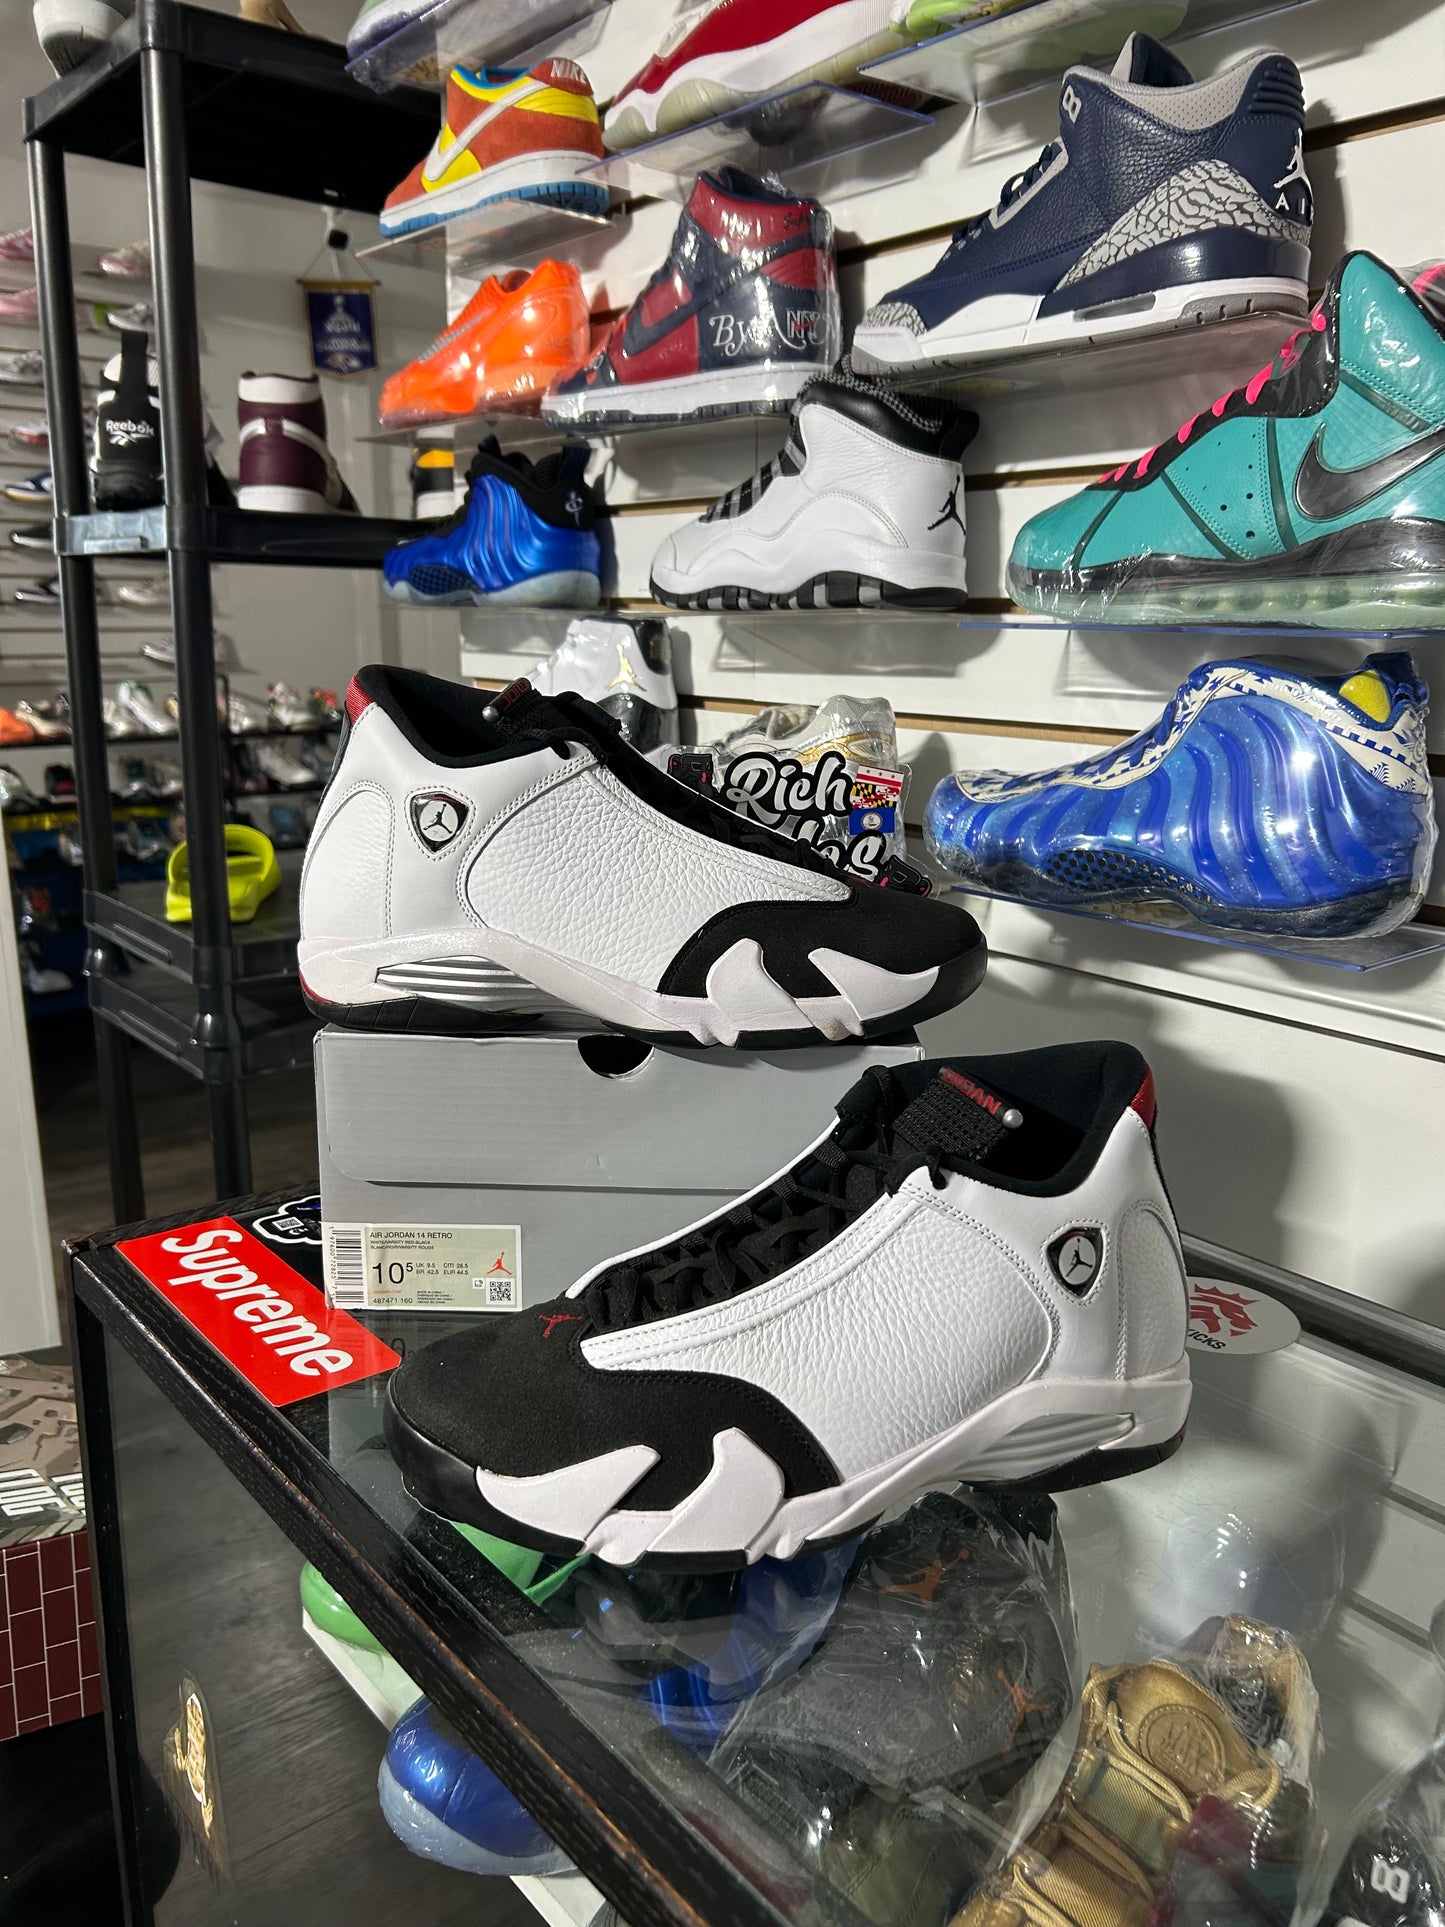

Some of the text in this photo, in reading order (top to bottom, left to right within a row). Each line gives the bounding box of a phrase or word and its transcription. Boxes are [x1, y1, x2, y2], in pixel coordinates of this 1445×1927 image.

[551, 59, 588, 84] NIKE
[1275, 192, 1307, 215] AI
[106, 419, 155, 437] Reebok
[503, 679, 530, 711] JORD
[726, 756, 847, 825] Rich
[940, 1067, 1003, 1116] ORDAN
[370, 1231, 383, 1239] AIR
[384, 1231, 415, 1239] JORDAN
[427, 1232, 453, 1240] RETRO
[161, 1229, 354, 1376] Supreme
